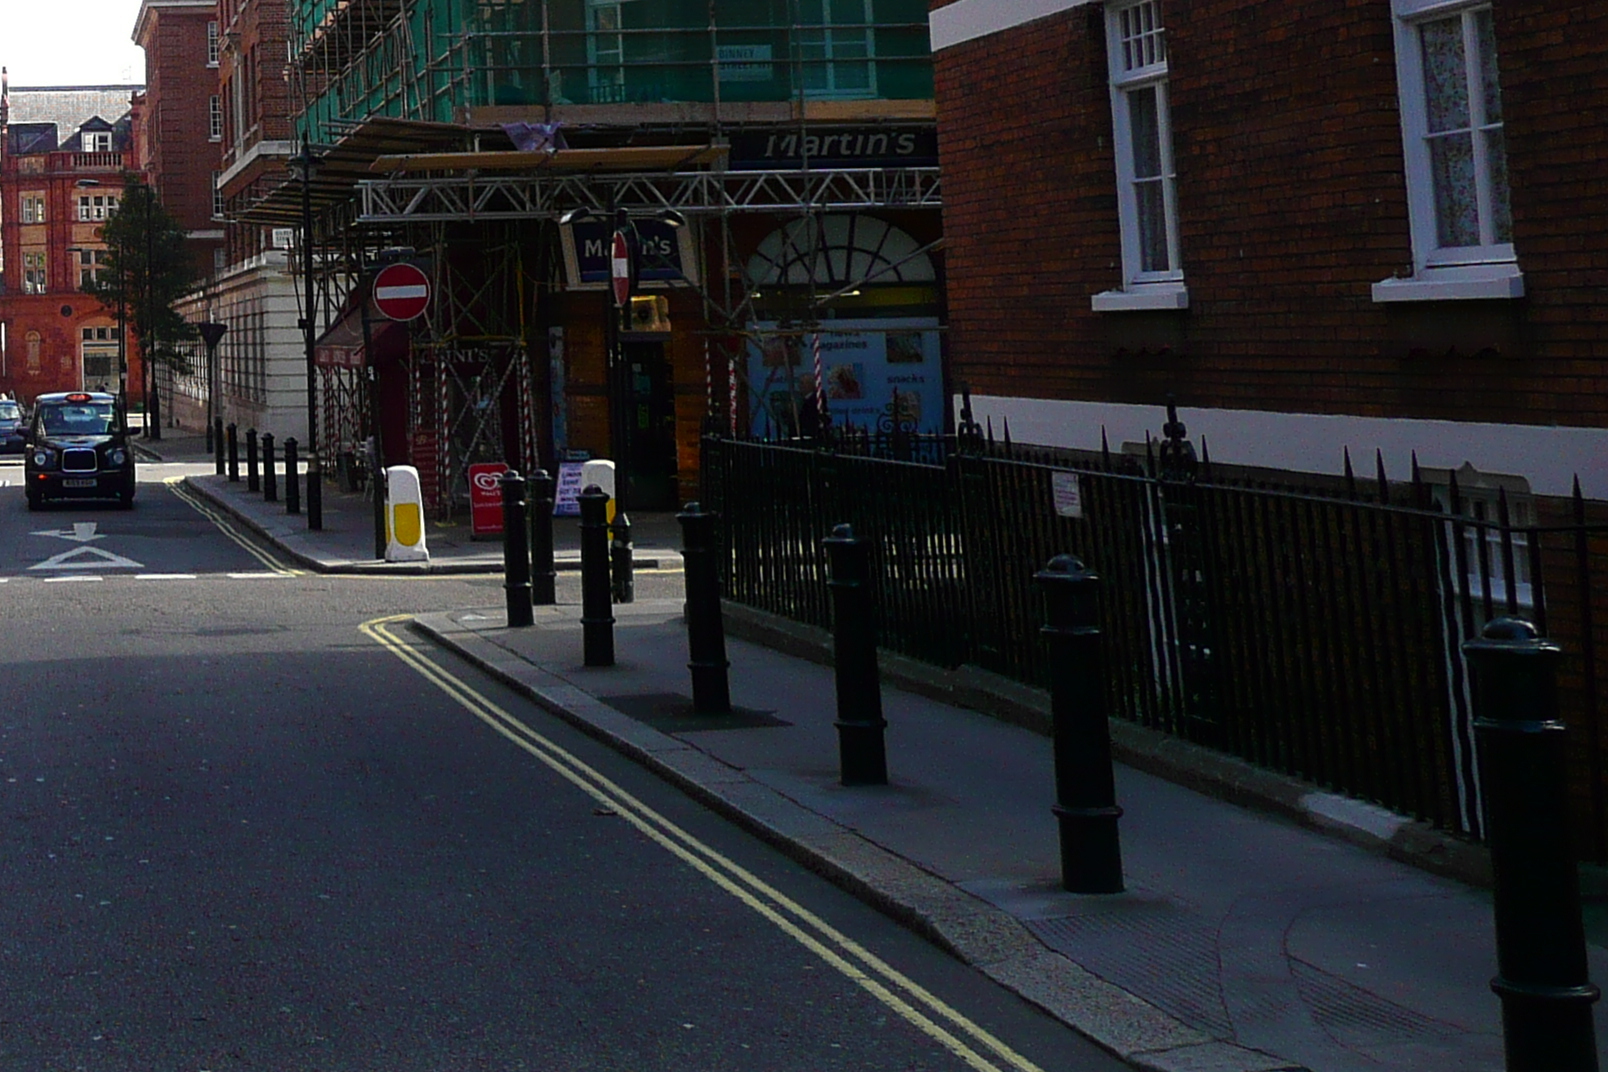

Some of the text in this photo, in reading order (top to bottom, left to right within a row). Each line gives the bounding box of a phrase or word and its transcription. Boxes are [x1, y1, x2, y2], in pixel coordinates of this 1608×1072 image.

[764, 131, 916, 158] Martin's
[809, 339, 868, 351] agazines
[887, 373, 926, 384] snacks
